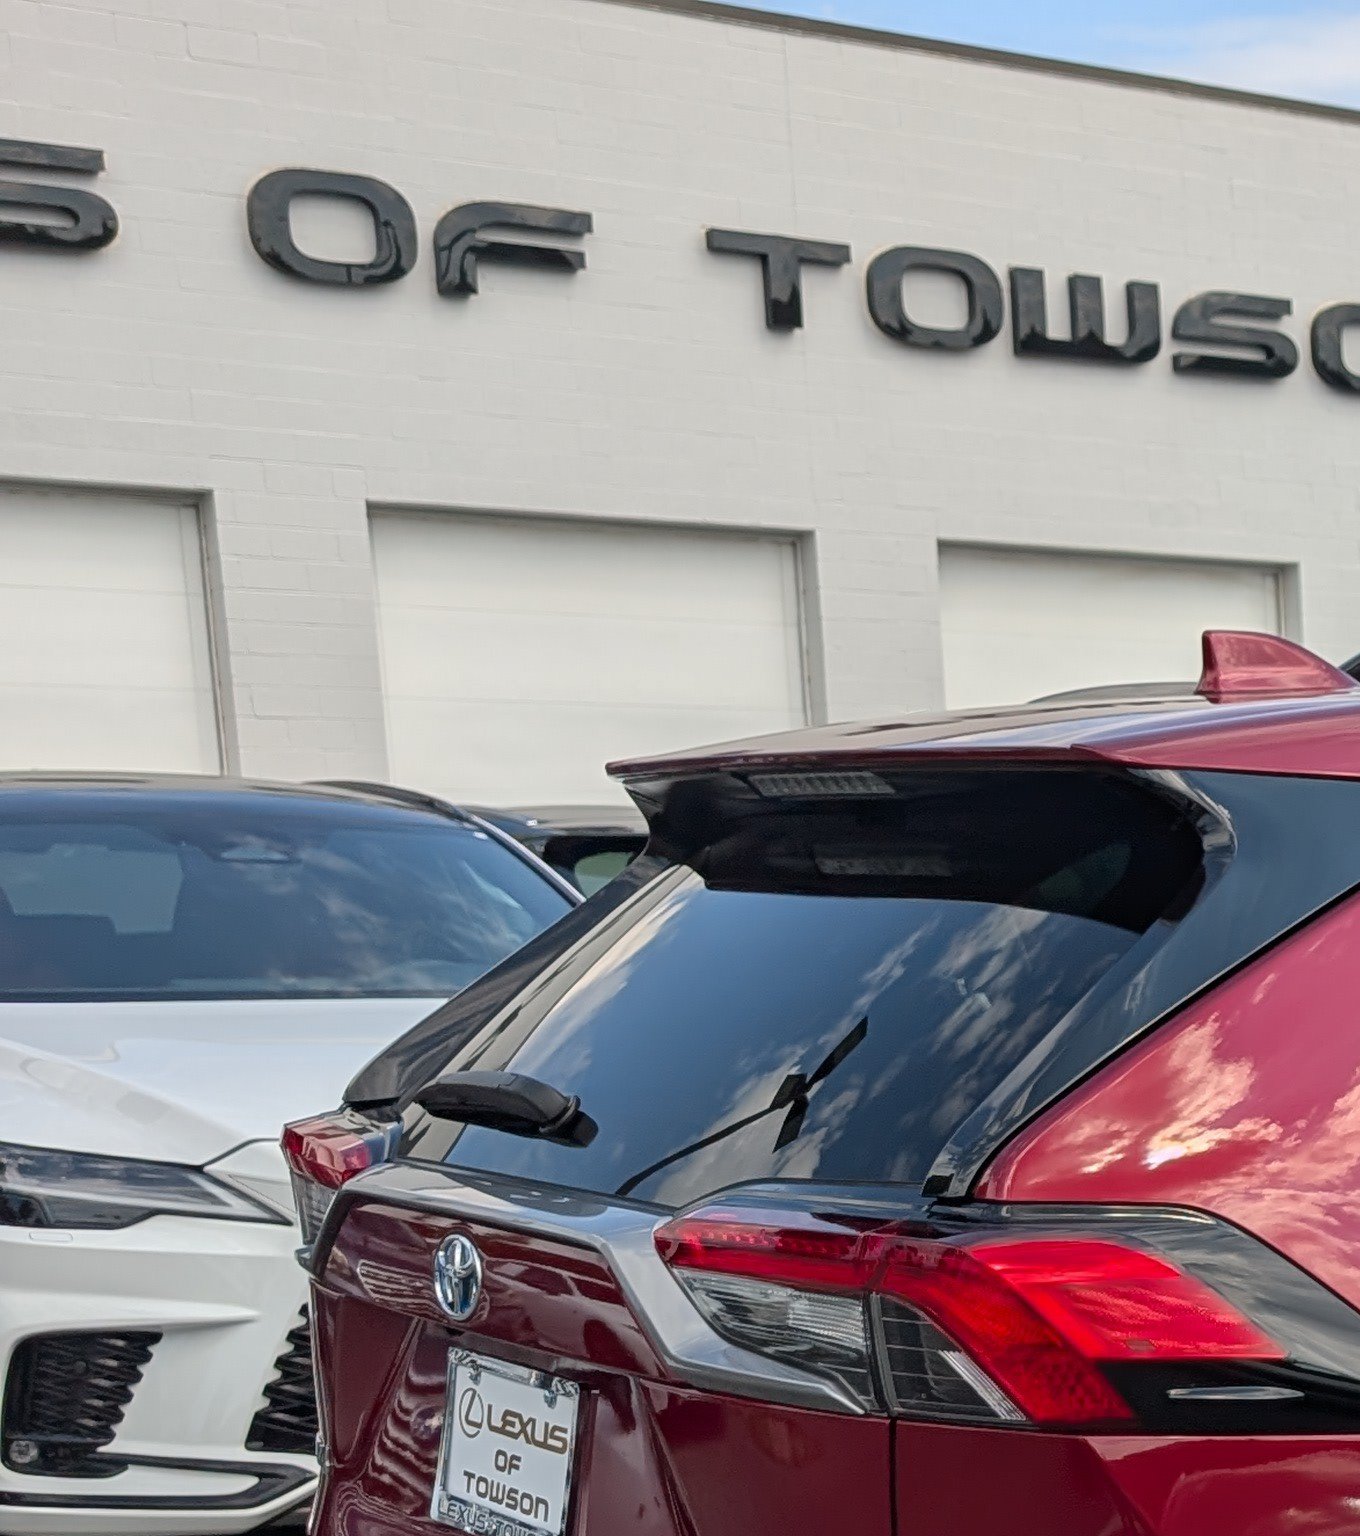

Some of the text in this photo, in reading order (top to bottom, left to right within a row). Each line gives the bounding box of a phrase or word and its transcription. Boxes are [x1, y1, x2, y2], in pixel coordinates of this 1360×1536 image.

[244, 166, 593, 299] OF
[487, 1403, 568, 1455] LEXUS
[494, 1449, 522, 1475] OF
[463, 1470, 549, 1522] TOWSON
